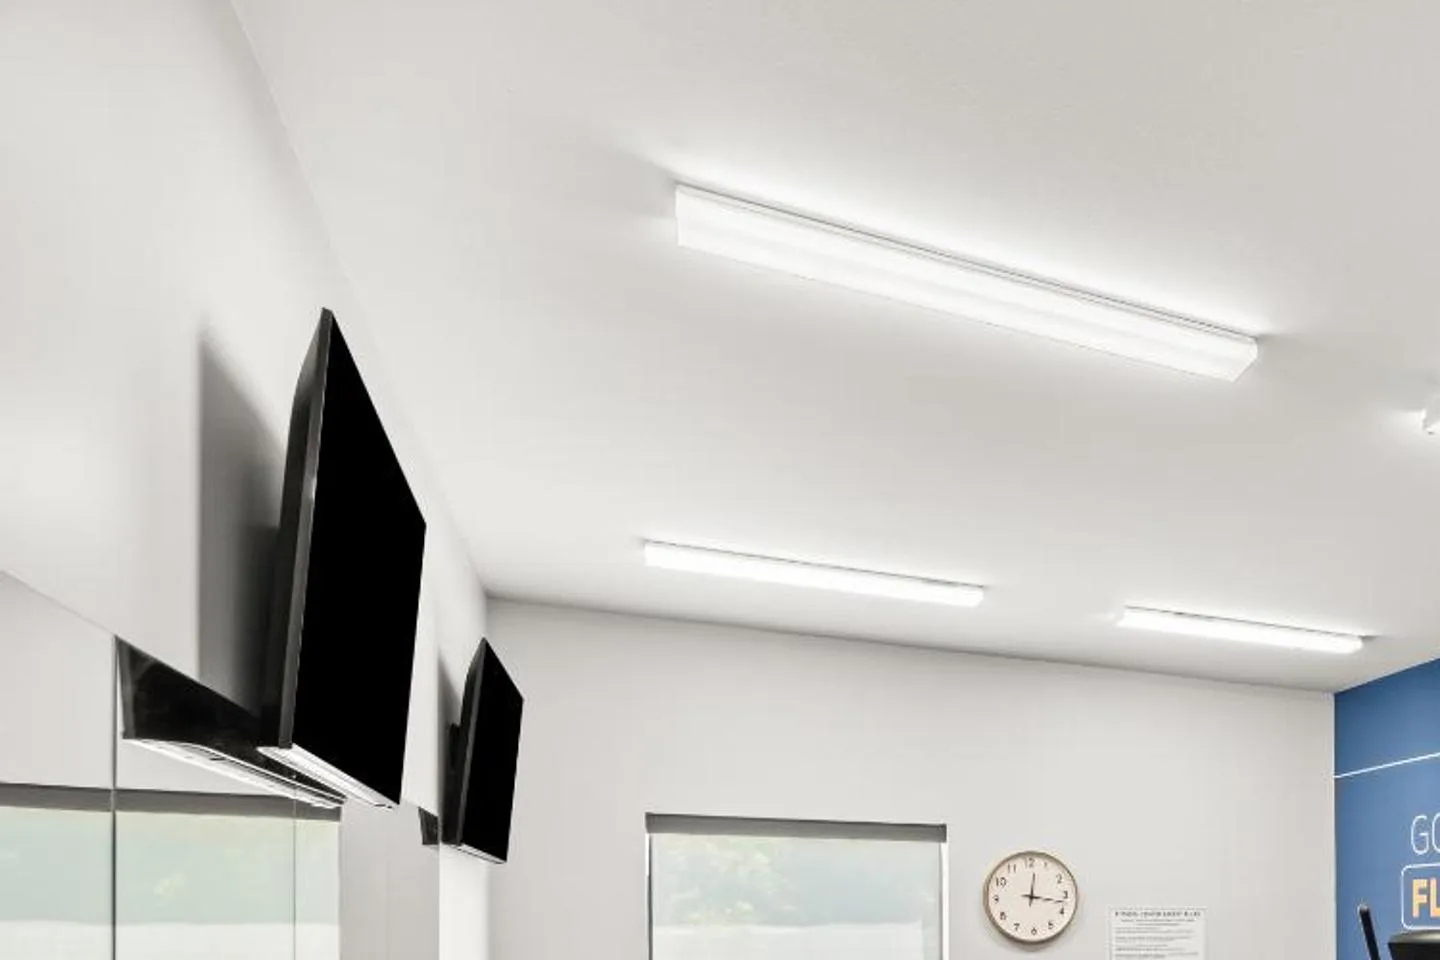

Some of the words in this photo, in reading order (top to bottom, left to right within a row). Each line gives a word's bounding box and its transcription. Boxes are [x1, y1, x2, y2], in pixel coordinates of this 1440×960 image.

[1007, 863, 1017, 873] 11
[1024, 857, 1035, 869] 12
[995, 876, 1007, 888] 10
[1056, 873, 1063, 884] 2
[993, 894, 999, 903] 9
[1062, 890, 1069, 899] 3
[1059, 905, 1065, 915] 4
[999, 911, 1007, 921] 8
[1013, 922, 1020, 931] 7
[1047, 921, 1054, 930] 5
[1031, 927, 1038, 936] 6
